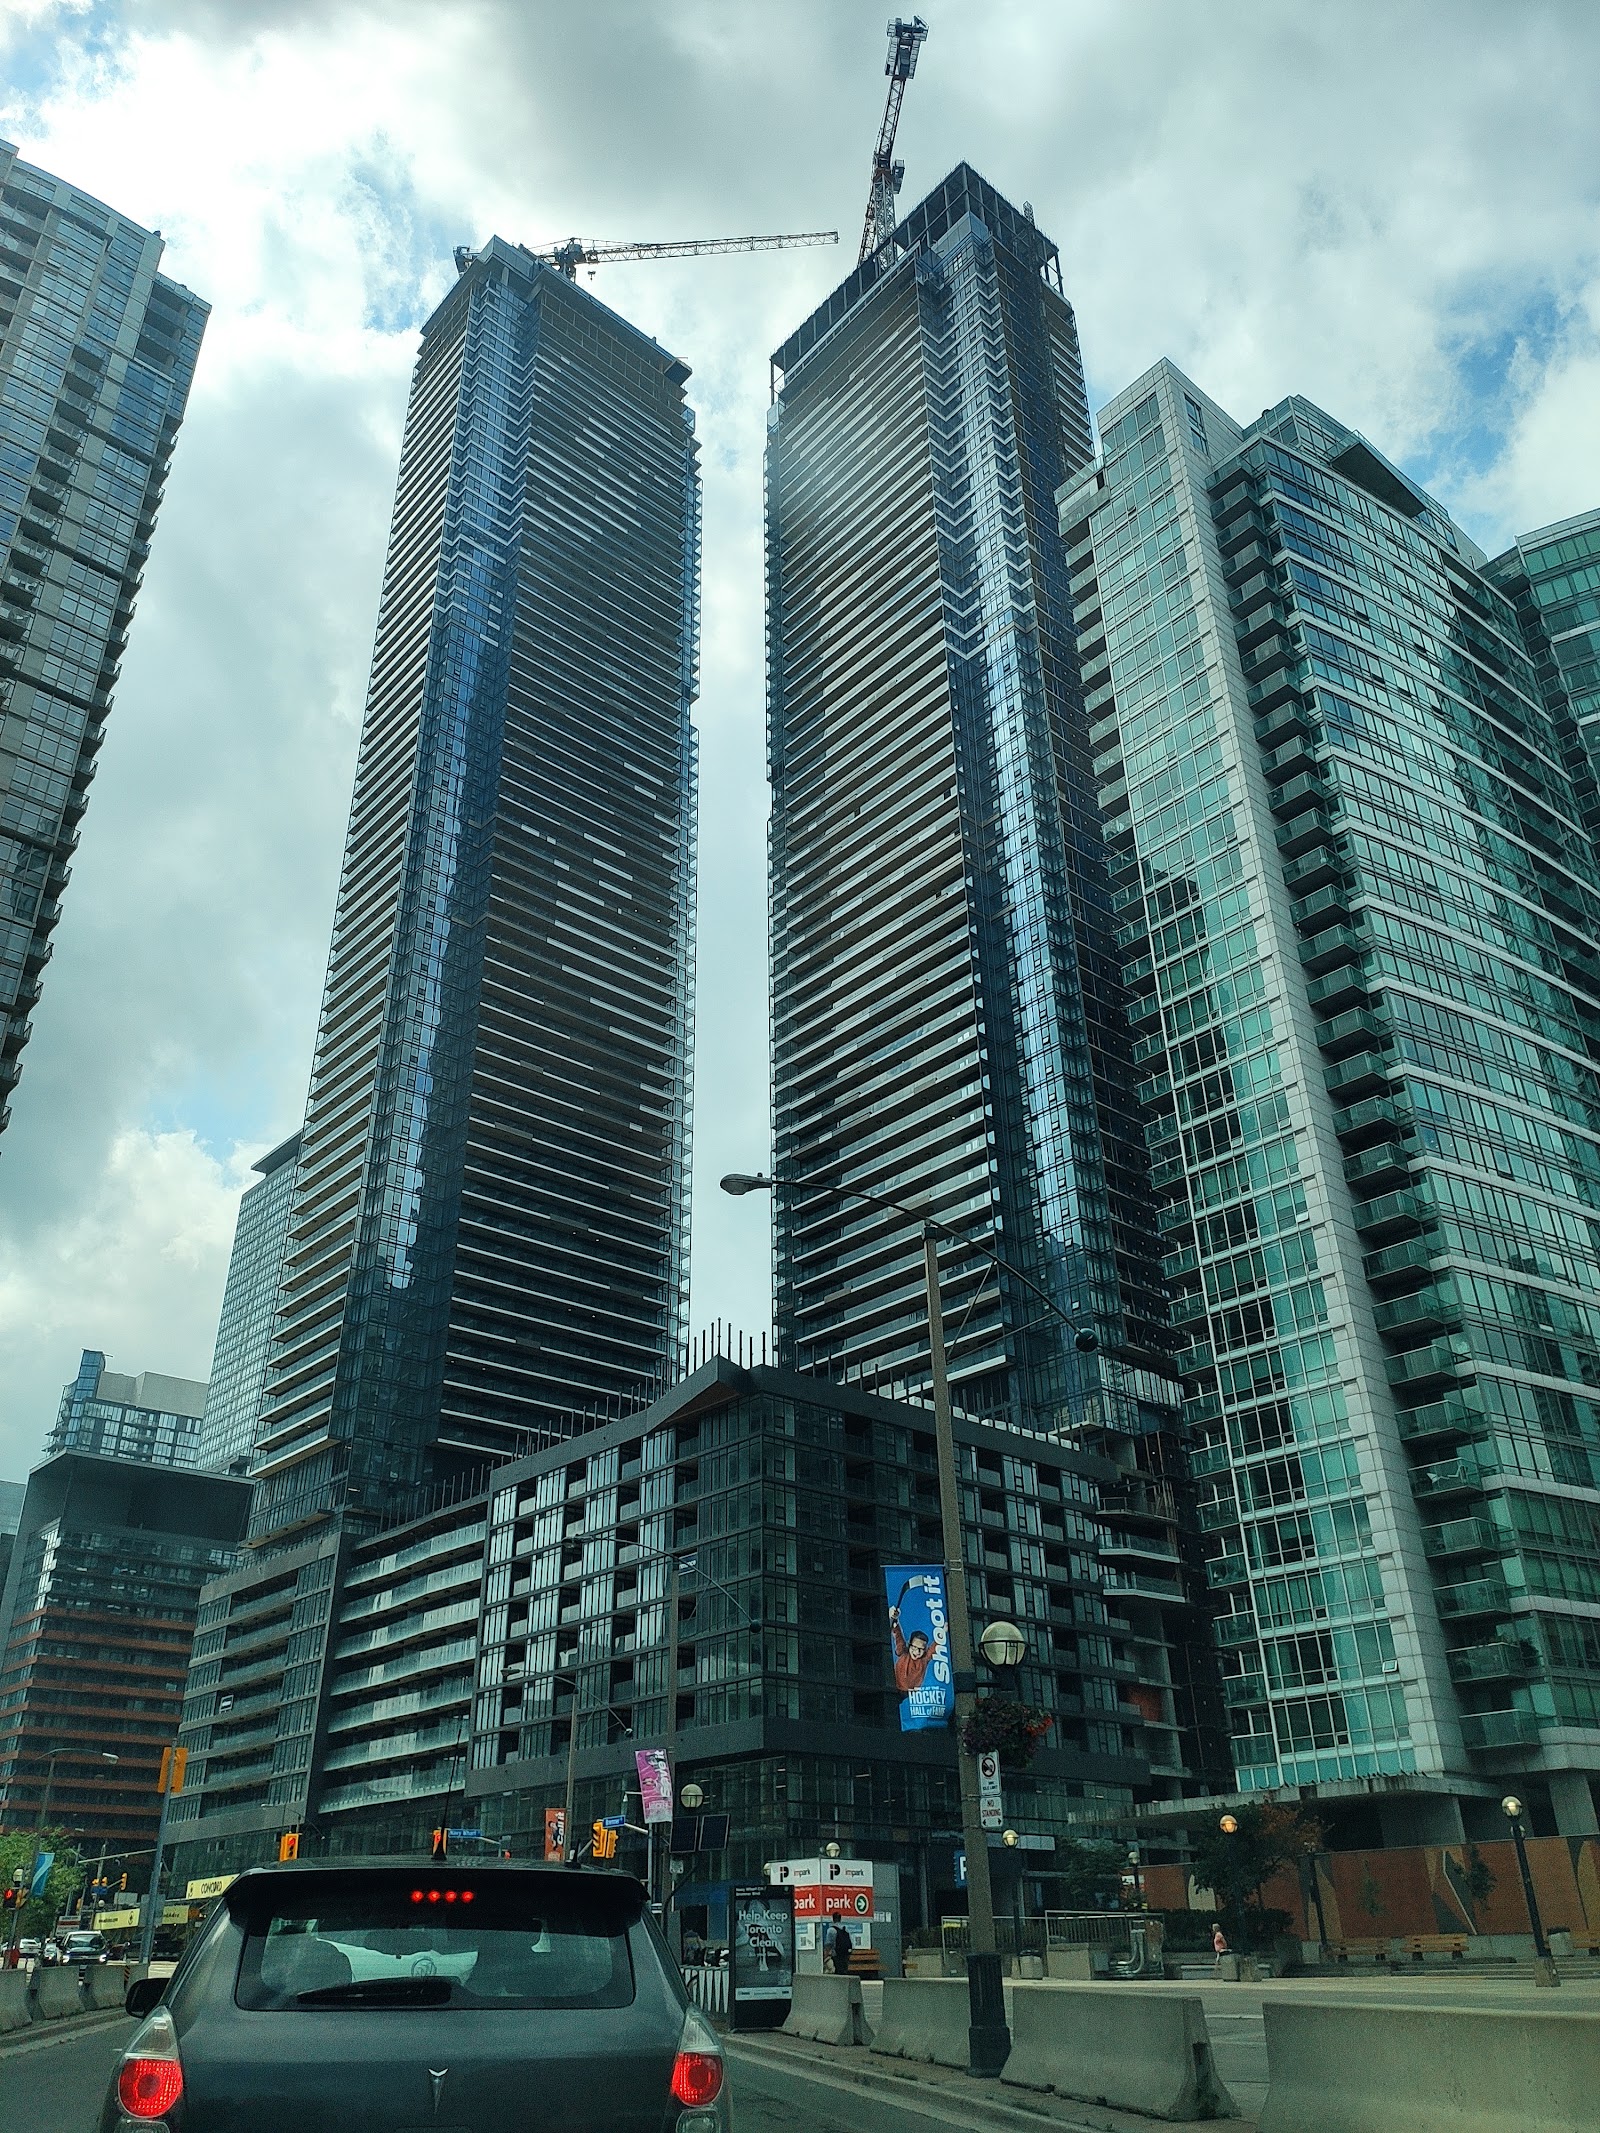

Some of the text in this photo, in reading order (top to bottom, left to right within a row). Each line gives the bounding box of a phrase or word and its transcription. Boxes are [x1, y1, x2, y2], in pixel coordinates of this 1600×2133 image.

[924, 1575, 941, 1594] it
[908, 1690, 946, 1704] HOCKEY
[910, 1706, 926, 1716] HALL
[987, 1799, 994, 1808] NO
[826, 1894, 851, 1912] park
[738, 1910, 788, 1922] Help Keep
[745, 1923, 782, 1934] Toronto
[749, 1936, 778, 1947] Clean
